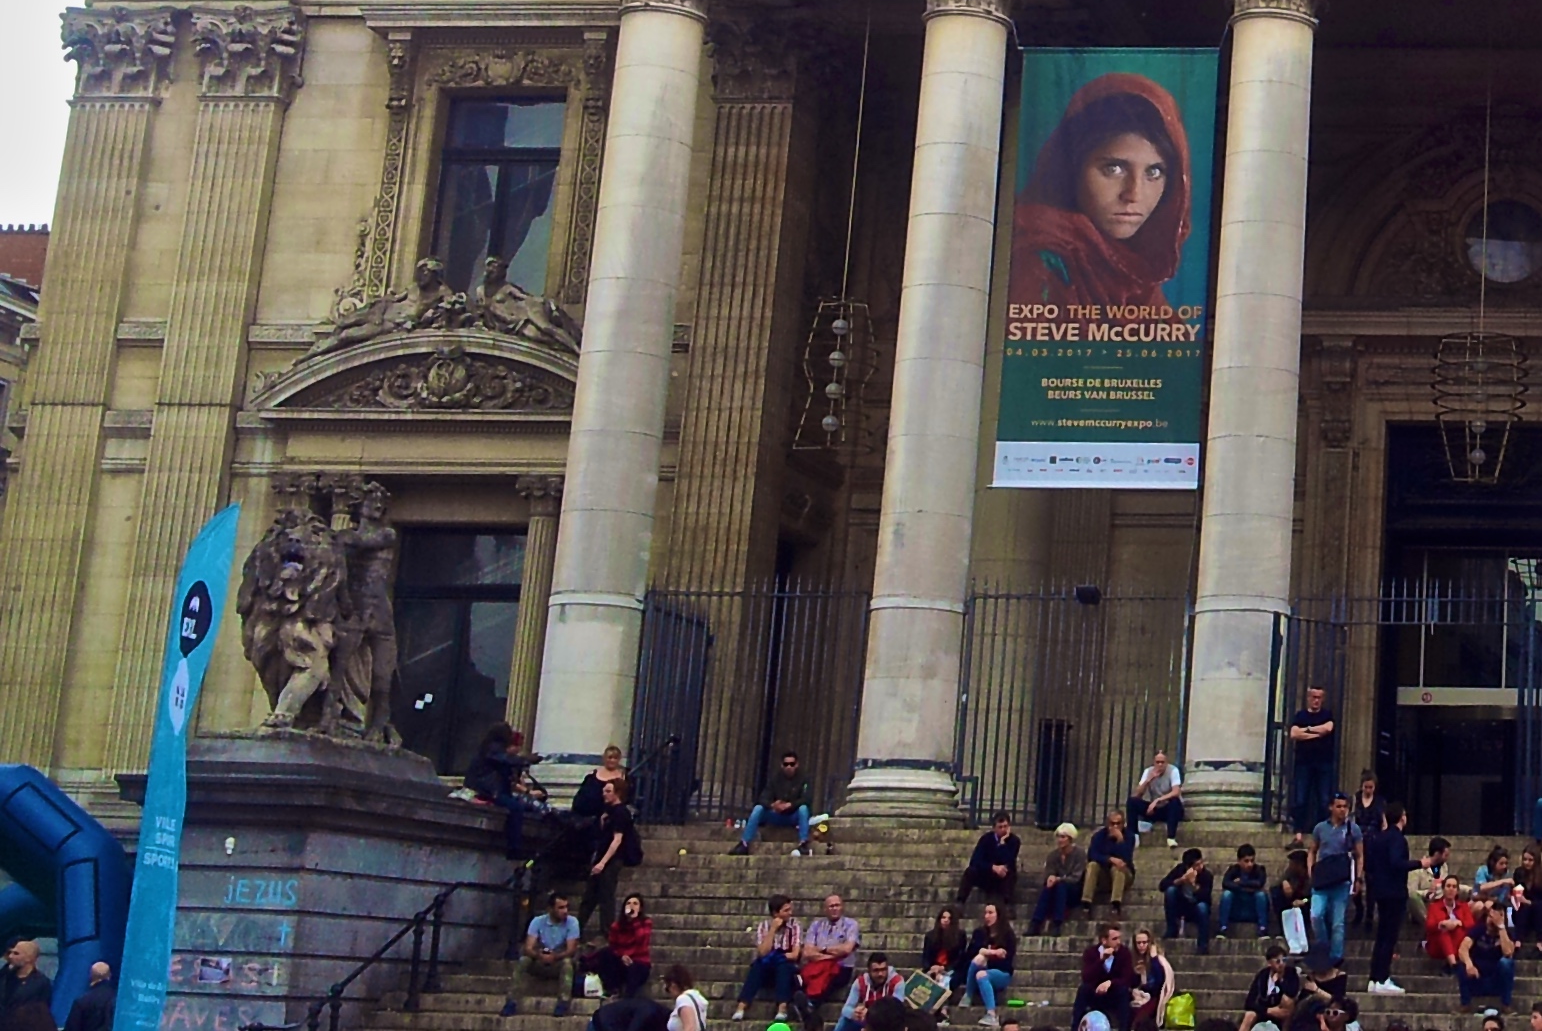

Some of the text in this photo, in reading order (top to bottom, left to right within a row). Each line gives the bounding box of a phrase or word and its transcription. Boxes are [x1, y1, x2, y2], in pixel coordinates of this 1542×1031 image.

[1008, 304, 1203, 320] EXPO THE WORLD OF
[1007, 322, 1201, 342] STEVE McCURRY
[1041, 378, 1162, 388] BOURSE DE BRUXELLES
[1047, 390, 1155, 400] BEURS VAN BRUSSEL
[1031, 418, 1168, 429] www.stevemccurryexpo.be
